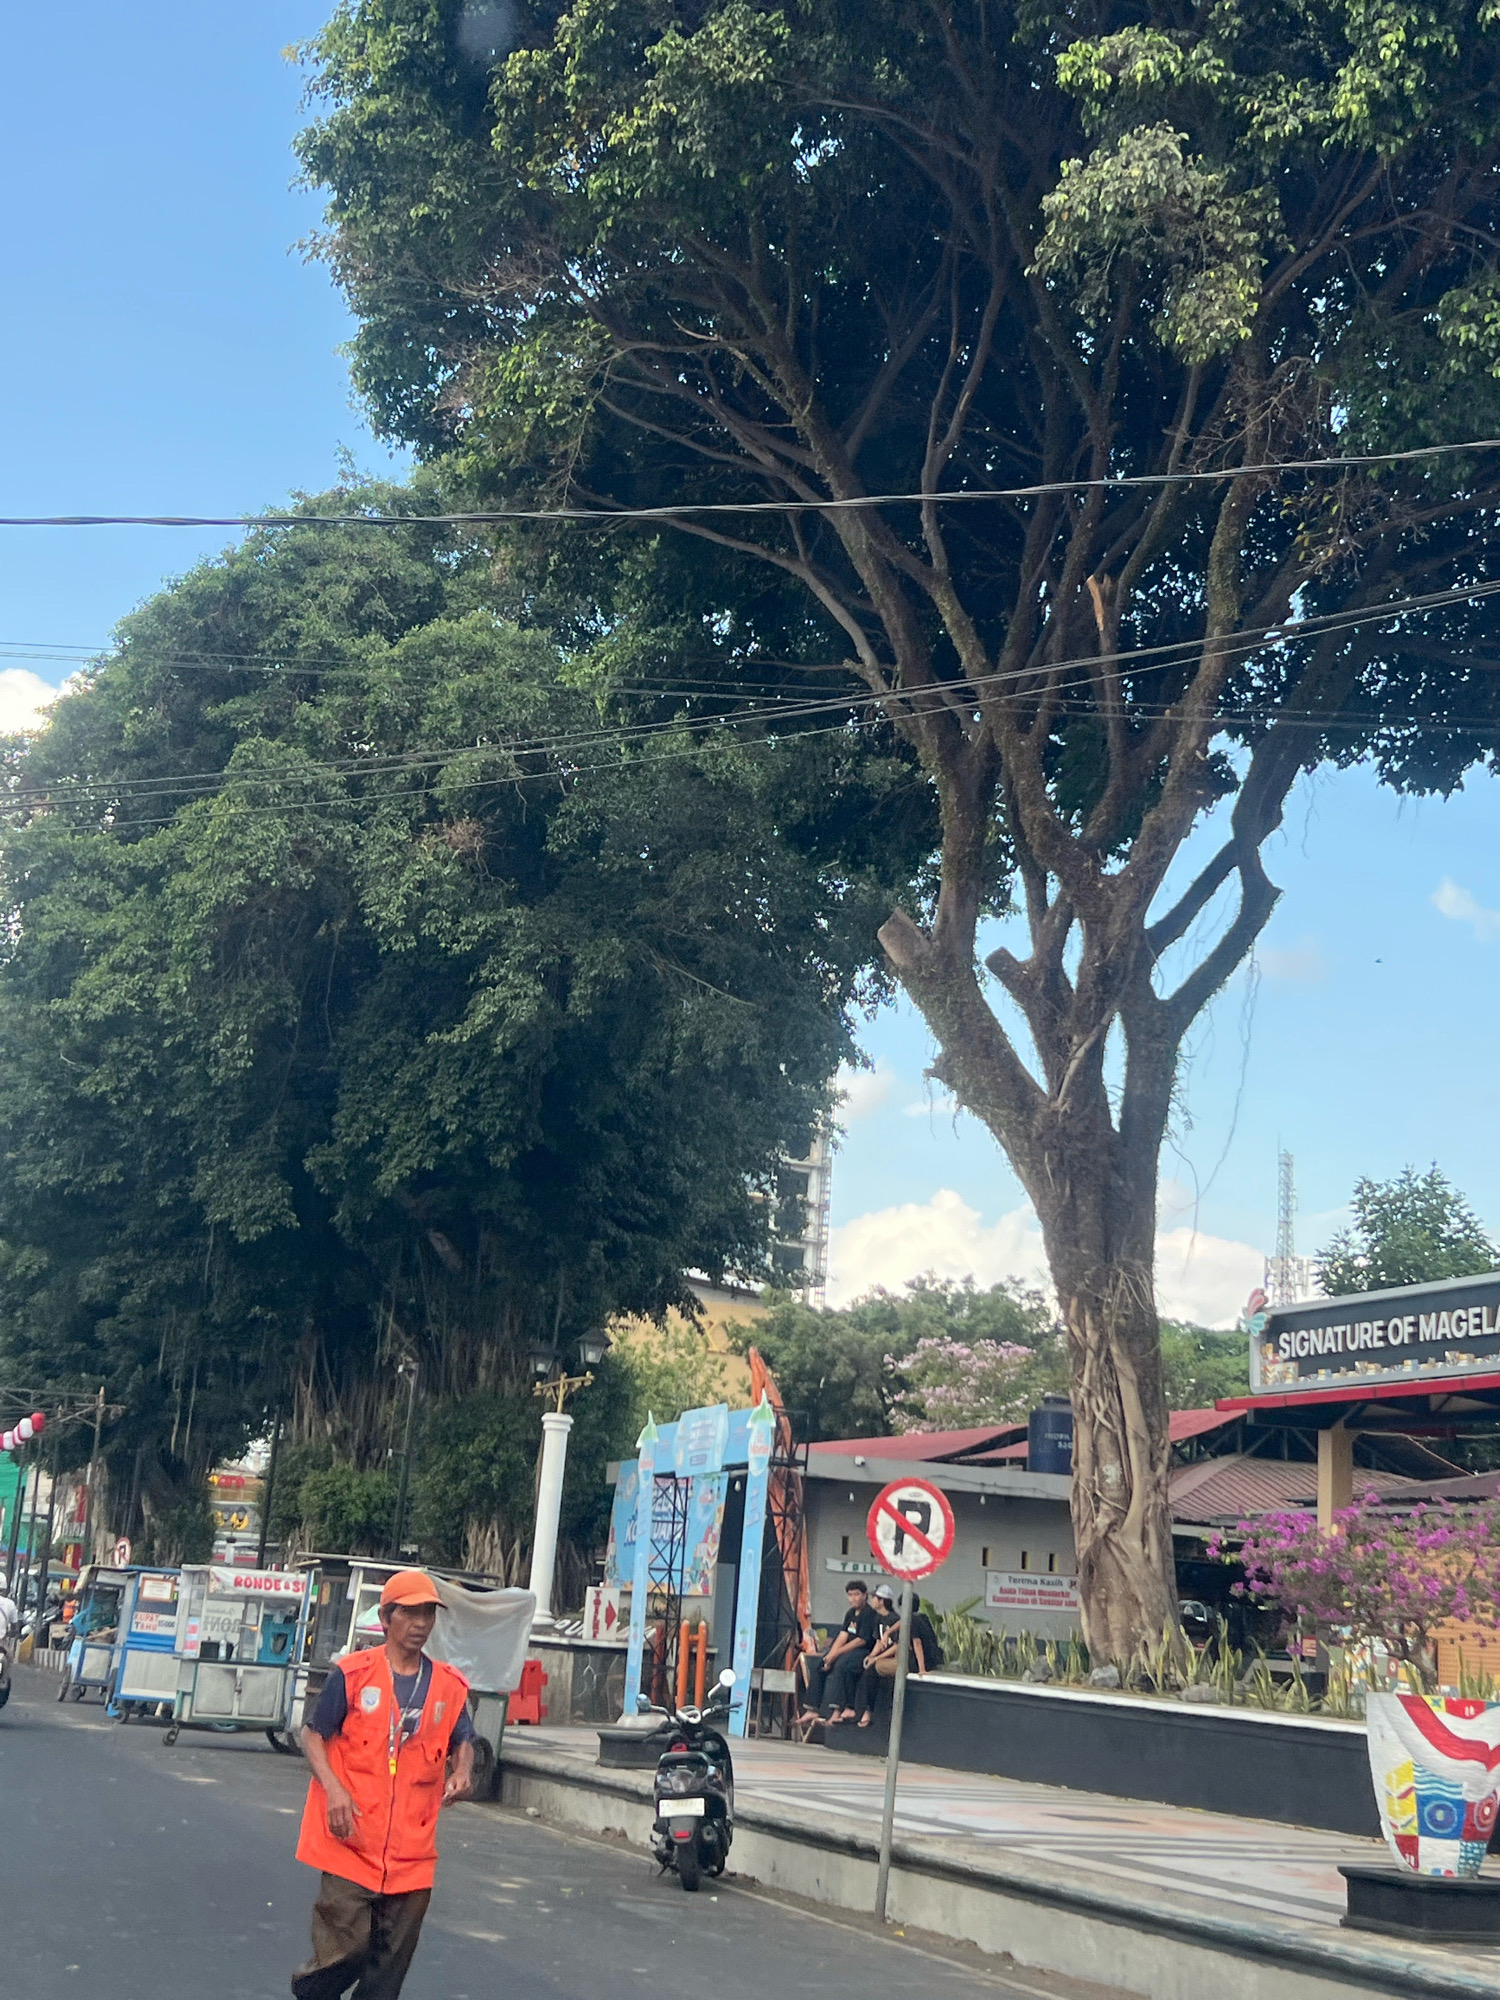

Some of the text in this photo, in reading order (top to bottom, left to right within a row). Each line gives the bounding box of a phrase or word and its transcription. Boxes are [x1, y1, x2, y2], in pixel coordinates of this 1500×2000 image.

[1278, 1320, 1385, 1360] SIGNATURE
[1387, 1315, 1415, 1347] OF
[234, 1576, 282, 1591] RONDE
[134, 1613, 160, 1623] KUPAT
[134, 1621, 158, 1631] TAHU
